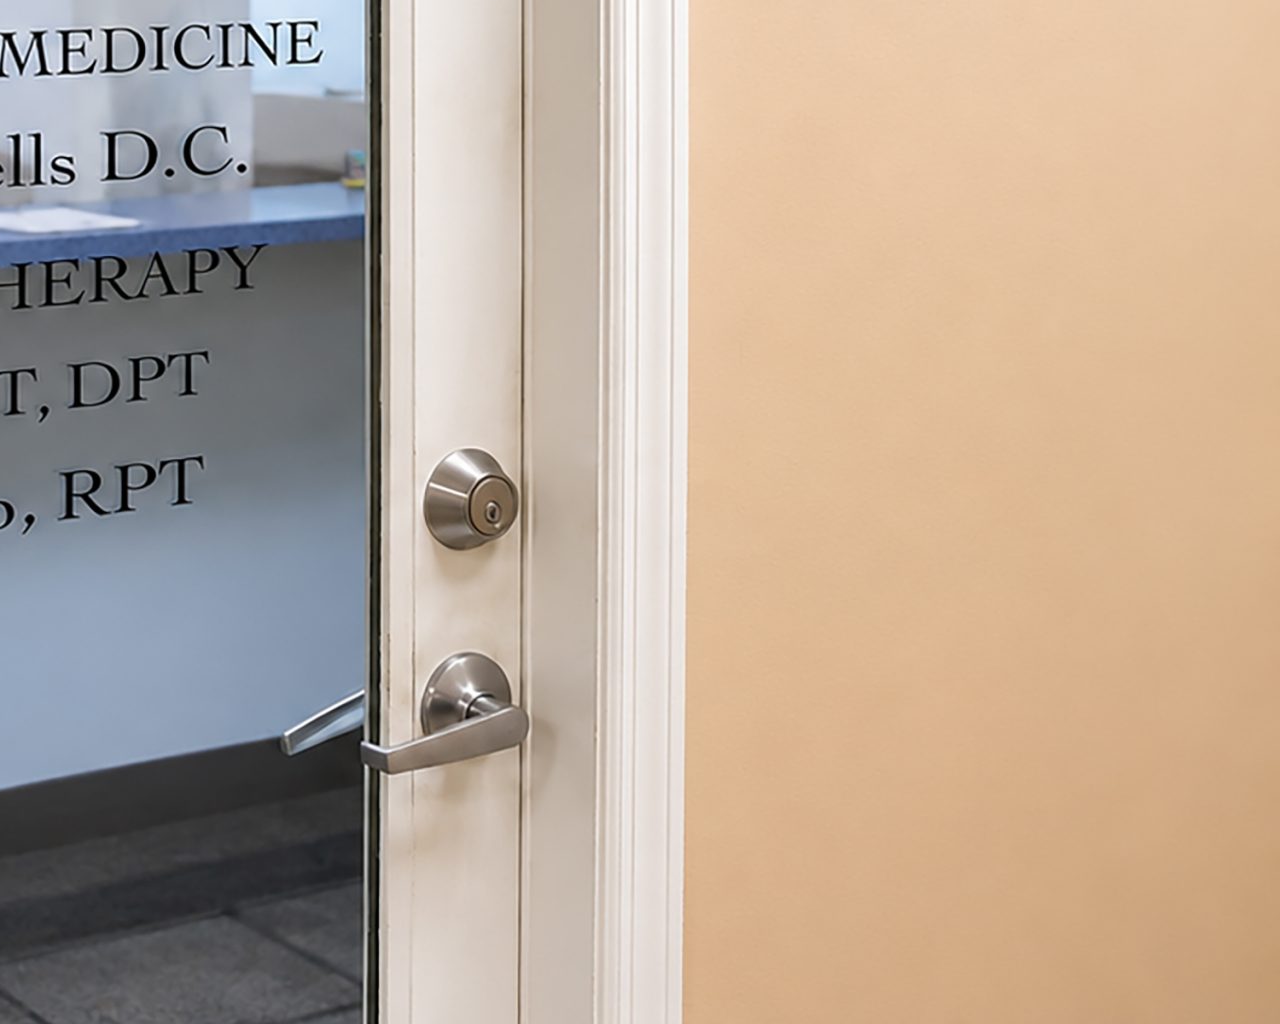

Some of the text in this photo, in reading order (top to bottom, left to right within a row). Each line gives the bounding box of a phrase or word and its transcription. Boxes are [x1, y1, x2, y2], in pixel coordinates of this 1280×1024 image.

[101, 125, 249, 182] D.C.
[66, 350, 209, 410] DPT
[59, 456, 204, 520] RPT
